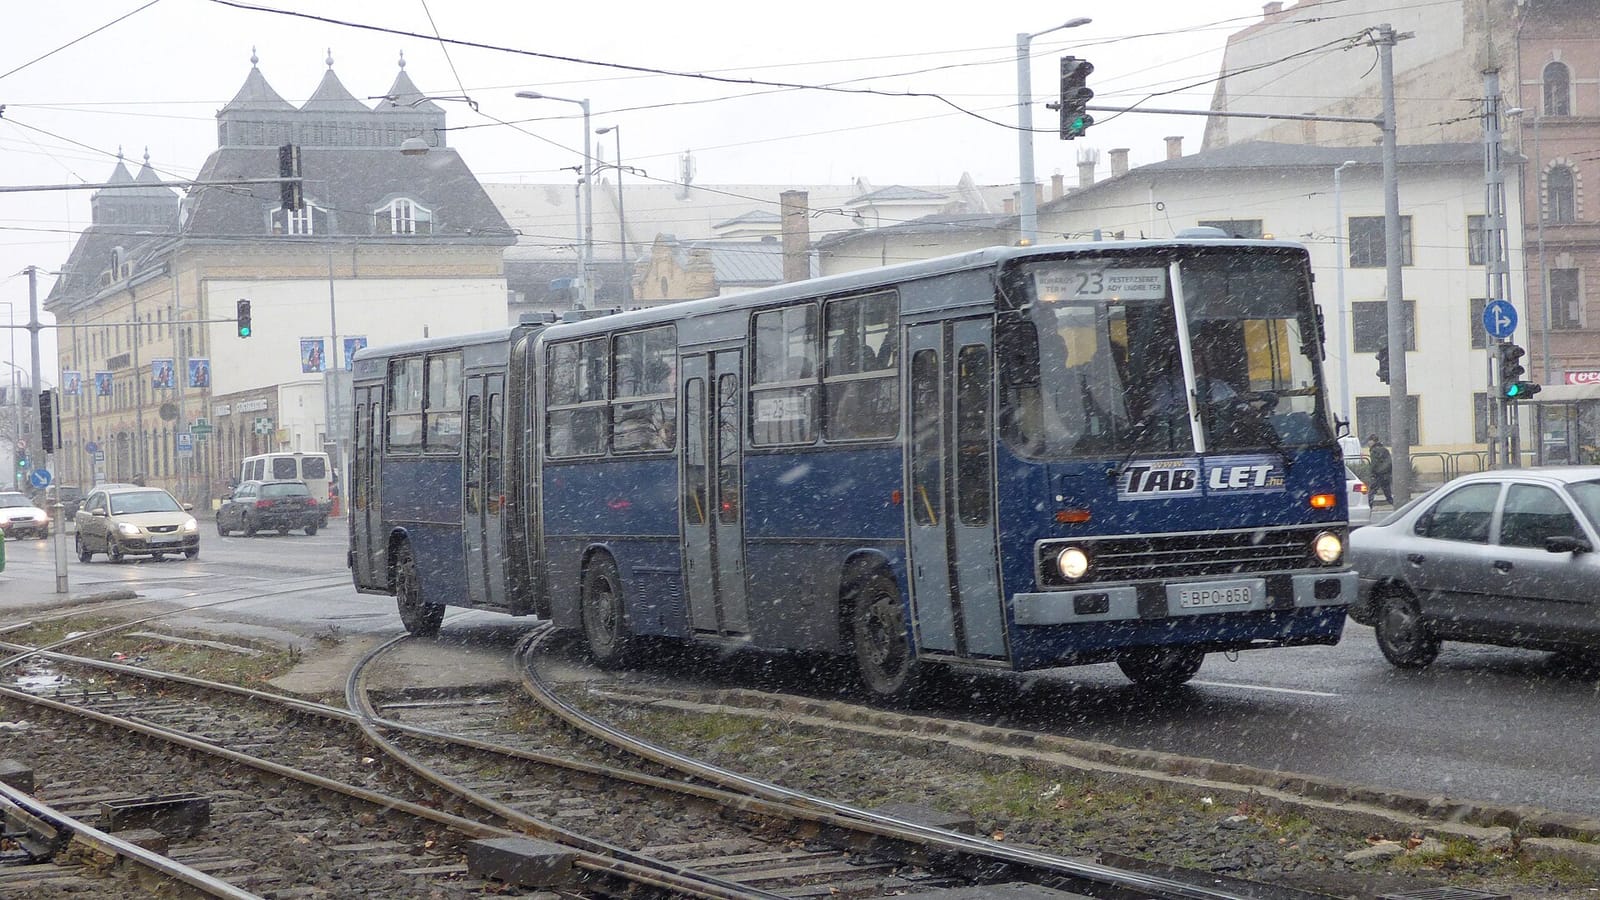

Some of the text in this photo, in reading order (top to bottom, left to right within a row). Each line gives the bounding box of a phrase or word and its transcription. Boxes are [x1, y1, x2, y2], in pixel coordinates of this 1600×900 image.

[1075, 271, 1103, 295] 23
[1569, 371, 1600, 385] Coc
[773, 399, 784, 418] 23
[1125, 466, 1197, 493] TAB
[1191, 588, 1249, 605] BPO-858
